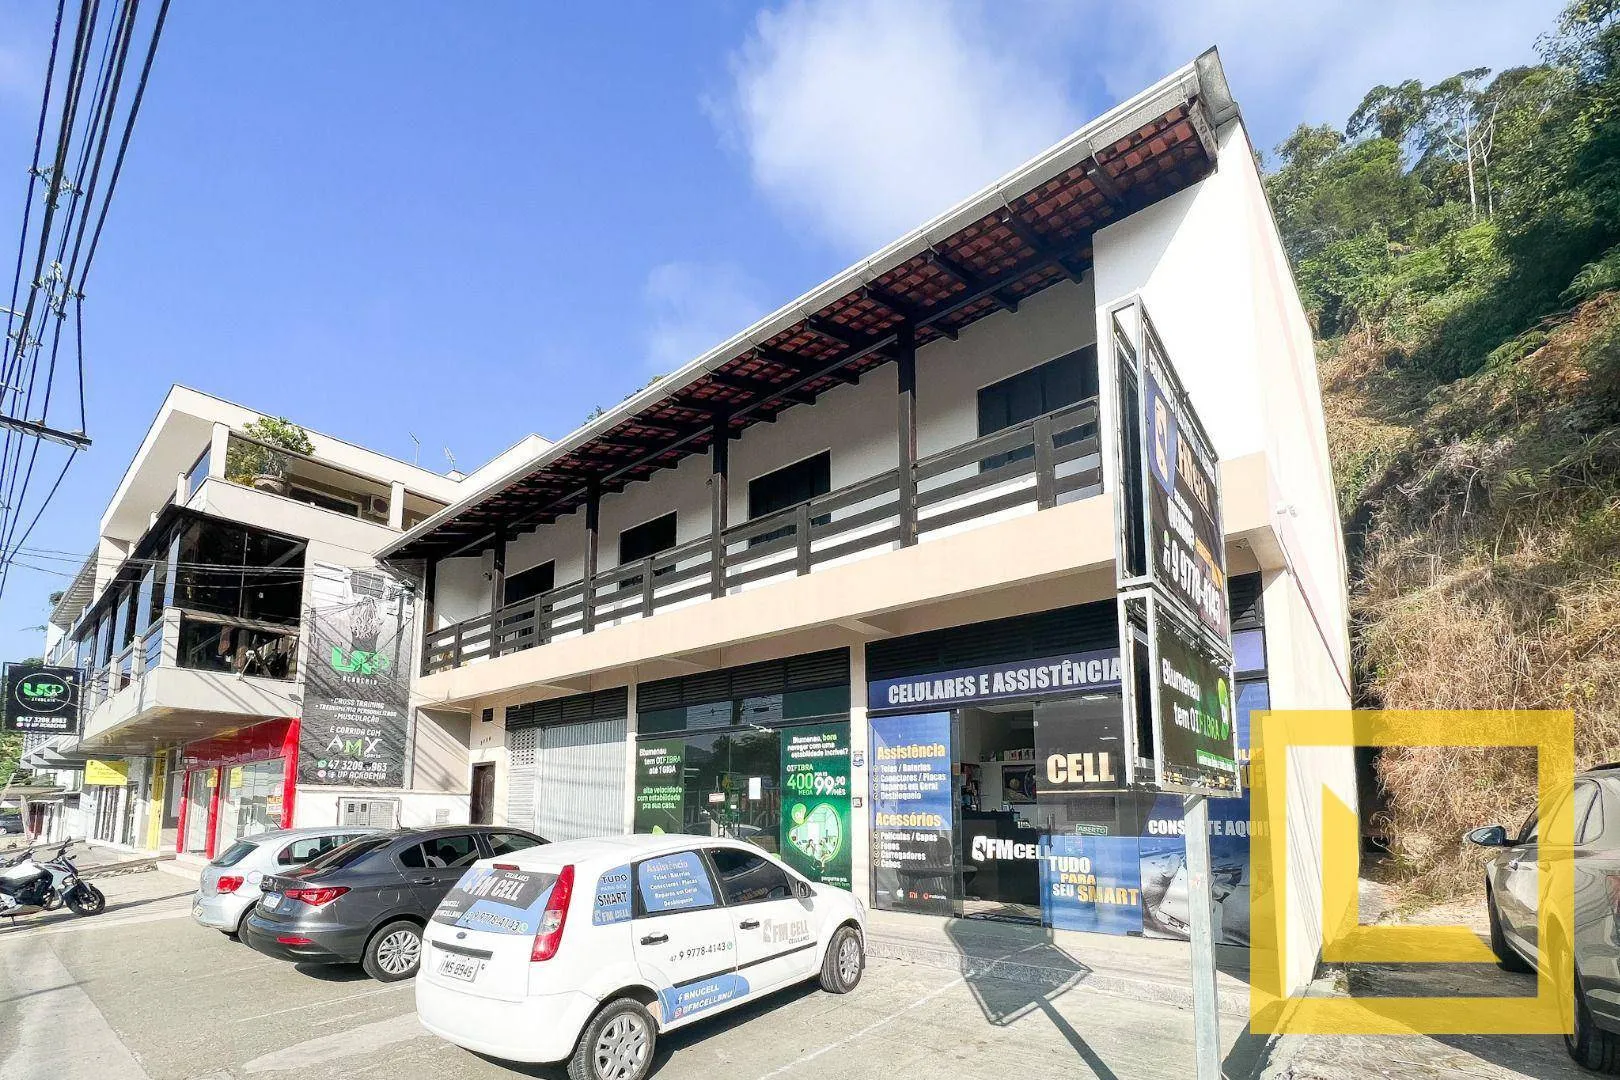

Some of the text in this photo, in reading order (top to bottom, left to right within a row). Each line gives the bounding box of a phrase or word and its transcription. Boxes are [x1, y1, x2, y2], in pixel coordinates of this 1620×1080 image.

[1172, 540, 1179, 582] 9
[1180, 550, 1221, 624] 9778-4143
[888, 657, 1122, 704] CELULARES E ASSISTÊNCIA
[1162, 658, 1200, 701] Blumenau
[334, 698, 385, 710] CROSS TRAINING
[337, 713, 380, 723] MUSCULAÇÃO
[1174, 701, 1190, 730] tem
[336, 726, 366, 735] CORRIDA
[367, 729, 381, 737] COM
[326, 734, 383, 757] AMX
[878, 743, 946, 760] Assistência
[328, 760, 339, 769] 47
[644, 758, 656, 766] tem
[881, 764, 898, 772] Telas
[1047, 752, 1115, 784] CELL
[349, 771, 386, 780] ACADEMIA
[648, 766, 658, 774] até
[662, 765, 676, 774] GIGA
[787, 772, 814, 790] 400
[881, 774, 918, 782] Conectores
[923, 772, 946, 781] Placas
[880, 791, 922, 800] Desbloqueio
[876, 812, 942, 826] Acessórios
[1148, 820, 1223, 836] CONSTE
[916, 832, 938, 842] Capas
[880, 850, 926, 860] Carregadores
[880, 860, 901, 868] Cabos
[1050, 856, 1091, 874] TUDO
[602, 874, 628, 884] TUDO
[1060, 873, 1096, 886] PARA
[491, 880, 526, 901] CELL
[1052, 884, 1139, 906] SEU SMART
[597, 892, 627, 907] SMART
[790, 920, 809, 937] CELL
[679, 951, 684, 960] 9
[686, 942, 726, 959] 9778-4143
[684, 984, 720, 999] BNUCELL
